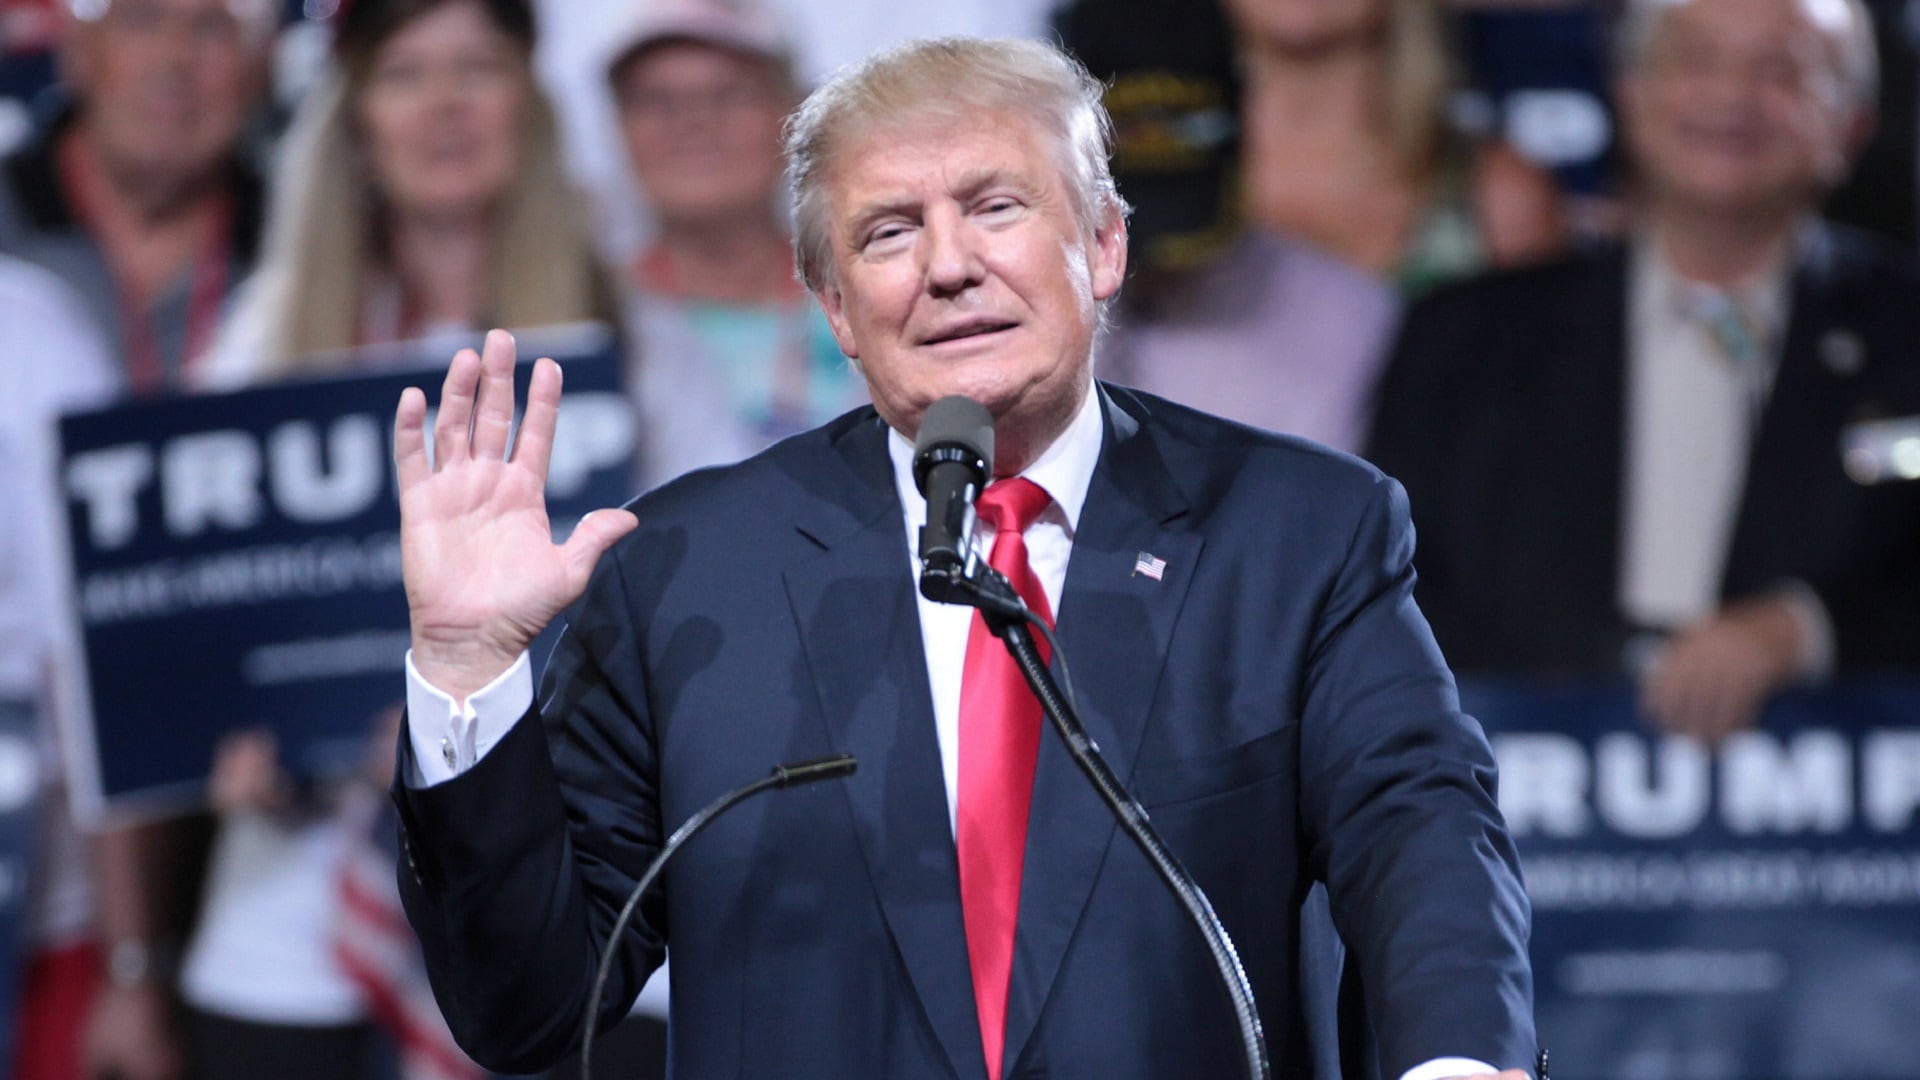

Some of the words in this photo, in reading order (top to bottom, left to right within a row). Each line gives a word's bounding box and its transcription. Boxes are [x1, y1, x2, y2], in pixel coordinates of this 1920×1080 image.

[66, 390, 638, 546] TRUP
[1492, 730, 1920, 838] RUMP
[1522, 852, 1686, 908] MERICA
